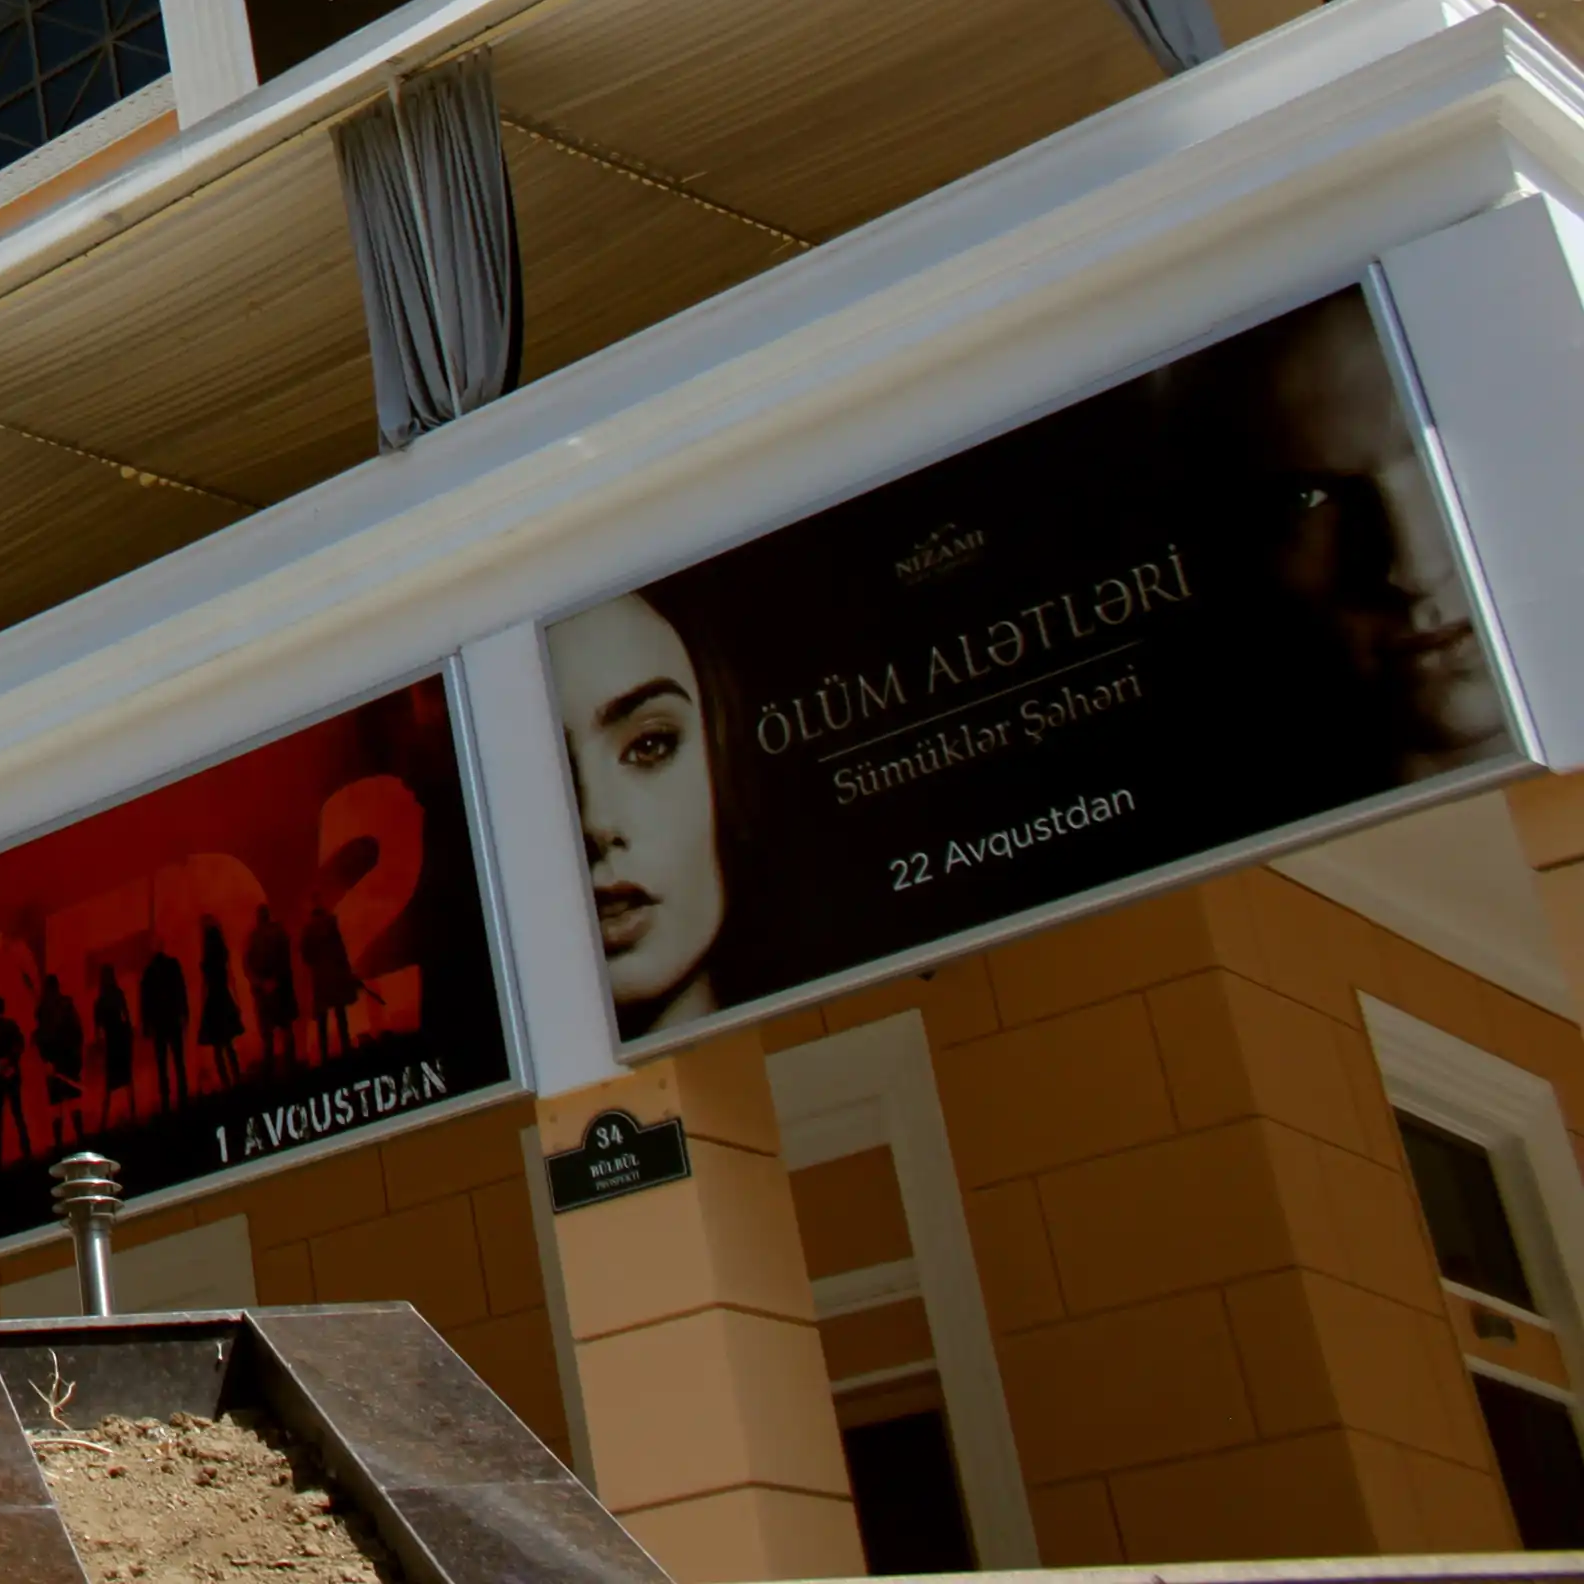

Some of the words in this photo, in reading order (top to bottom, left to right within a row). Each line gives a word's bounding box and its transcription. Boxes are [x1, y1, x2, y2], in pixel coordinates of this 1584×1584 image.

[757, 663, 908, 755] ÖLÜM
[927, 543, 1193, 693] ALƏTLƏRİ
[833, 721, 1012, 805] Sümüklər
[1019, 665, 1144, 744] Şəhəri
[889, 852, 933, 892] 22
[943, 787, 1137, 875] Avqustdan
[215, 1125, 229, 1163] 1
